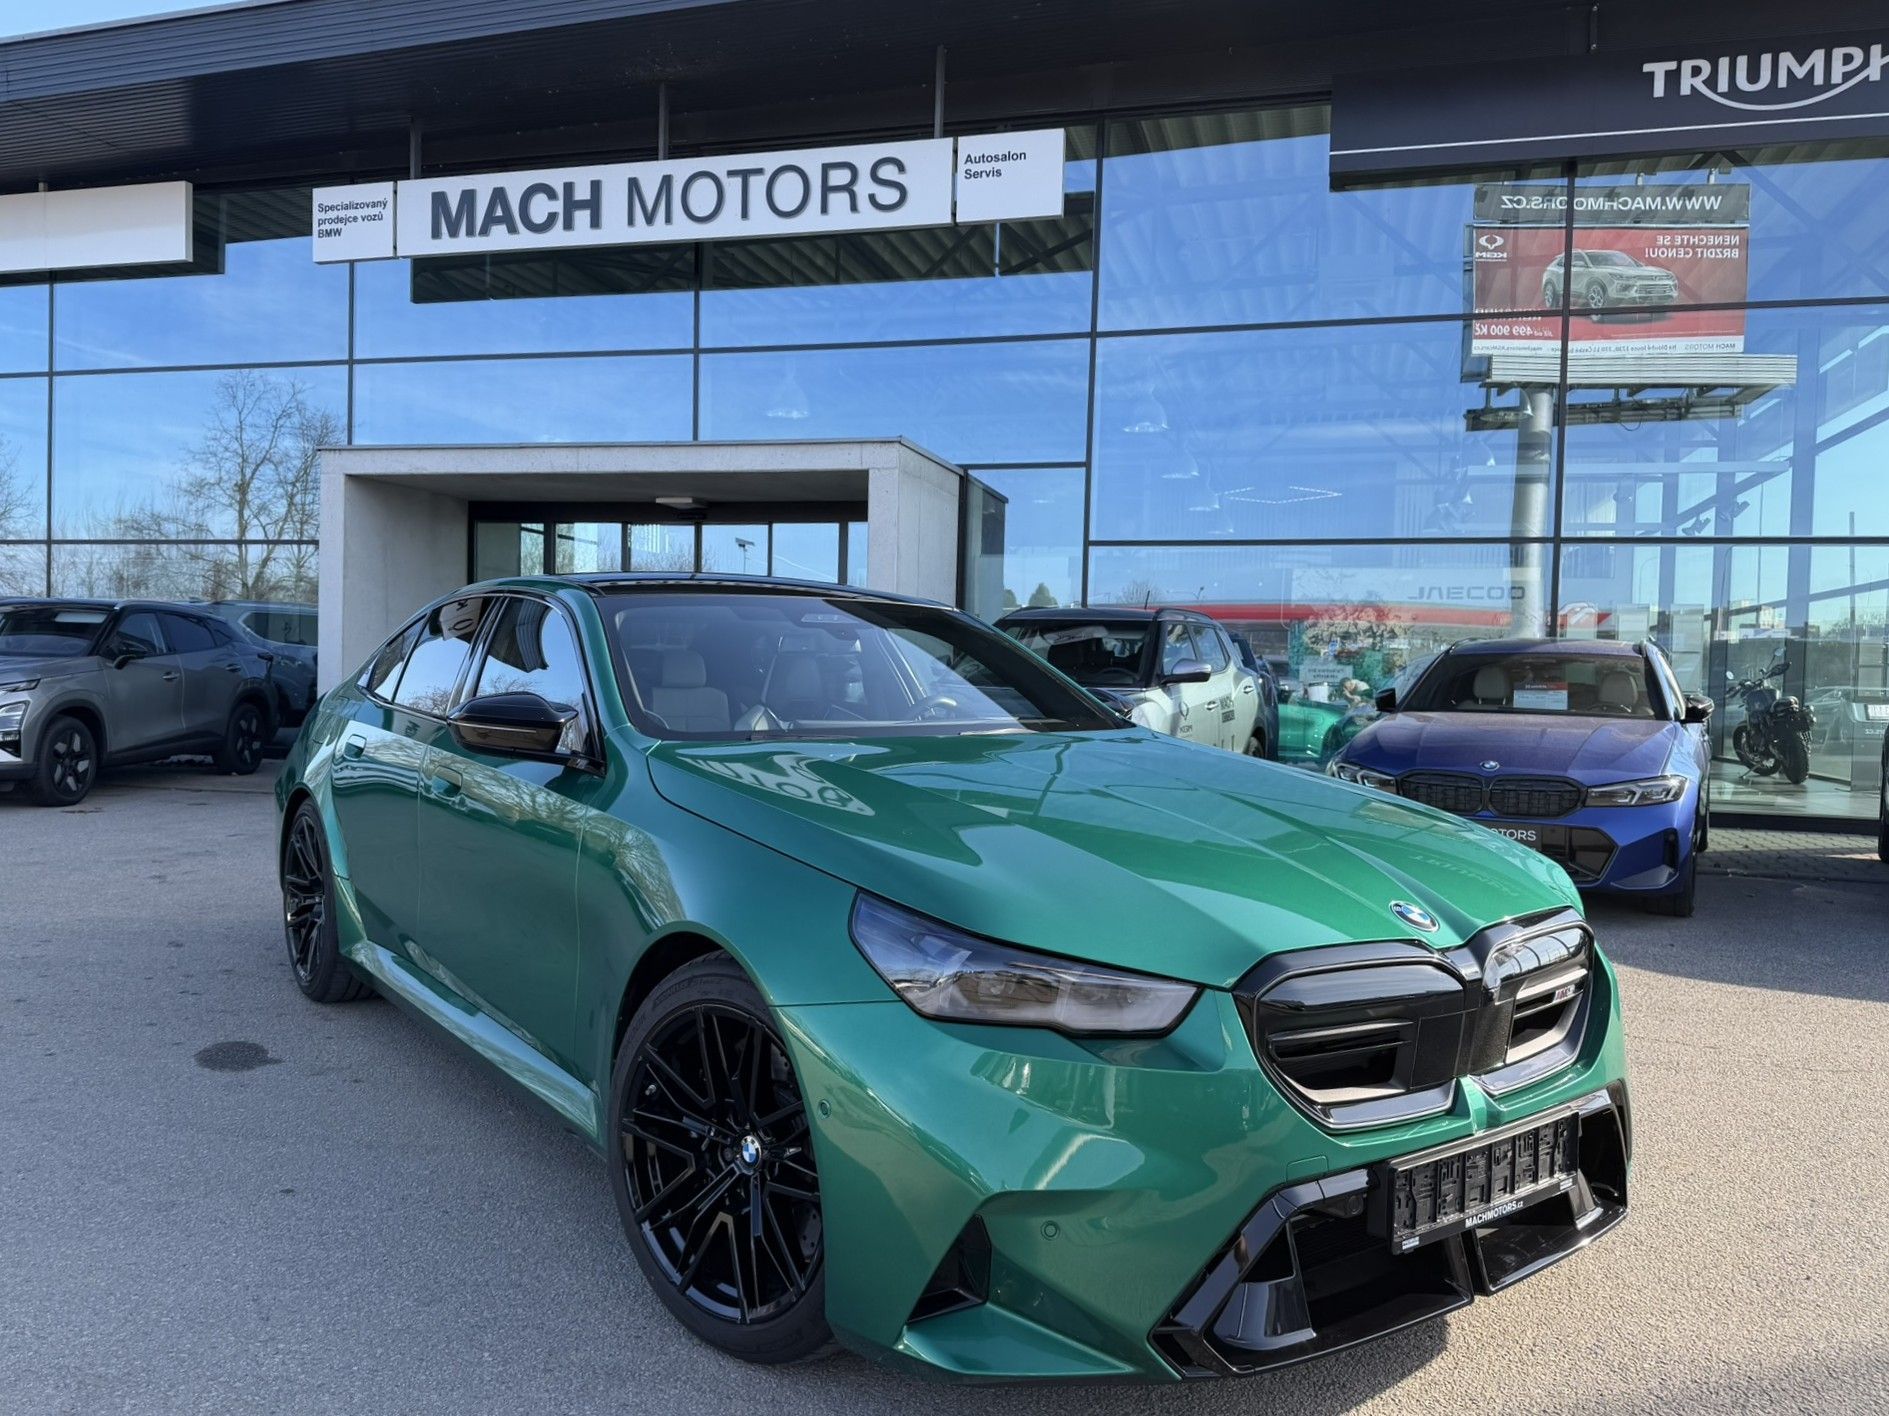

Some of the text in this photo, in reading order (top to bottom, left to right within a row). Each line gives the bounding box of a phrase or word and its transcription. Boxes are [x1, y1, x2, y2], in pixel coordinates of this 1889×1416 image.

[964, 150, 1027, 165] Autosalon
[964, 167, 1002, 180] Servis
[317, 197, 388, 214] Specializovaný
[430, 156, 908, 240] MACH MOTORS
[317, 210, 383, 228] prodejce vozů
[317, 227, 343, 239] BMW
[1407, 586, 1526, 600] JAECOO
[1465, 1200, 1524, 1228] MACHMOTORS.cz
